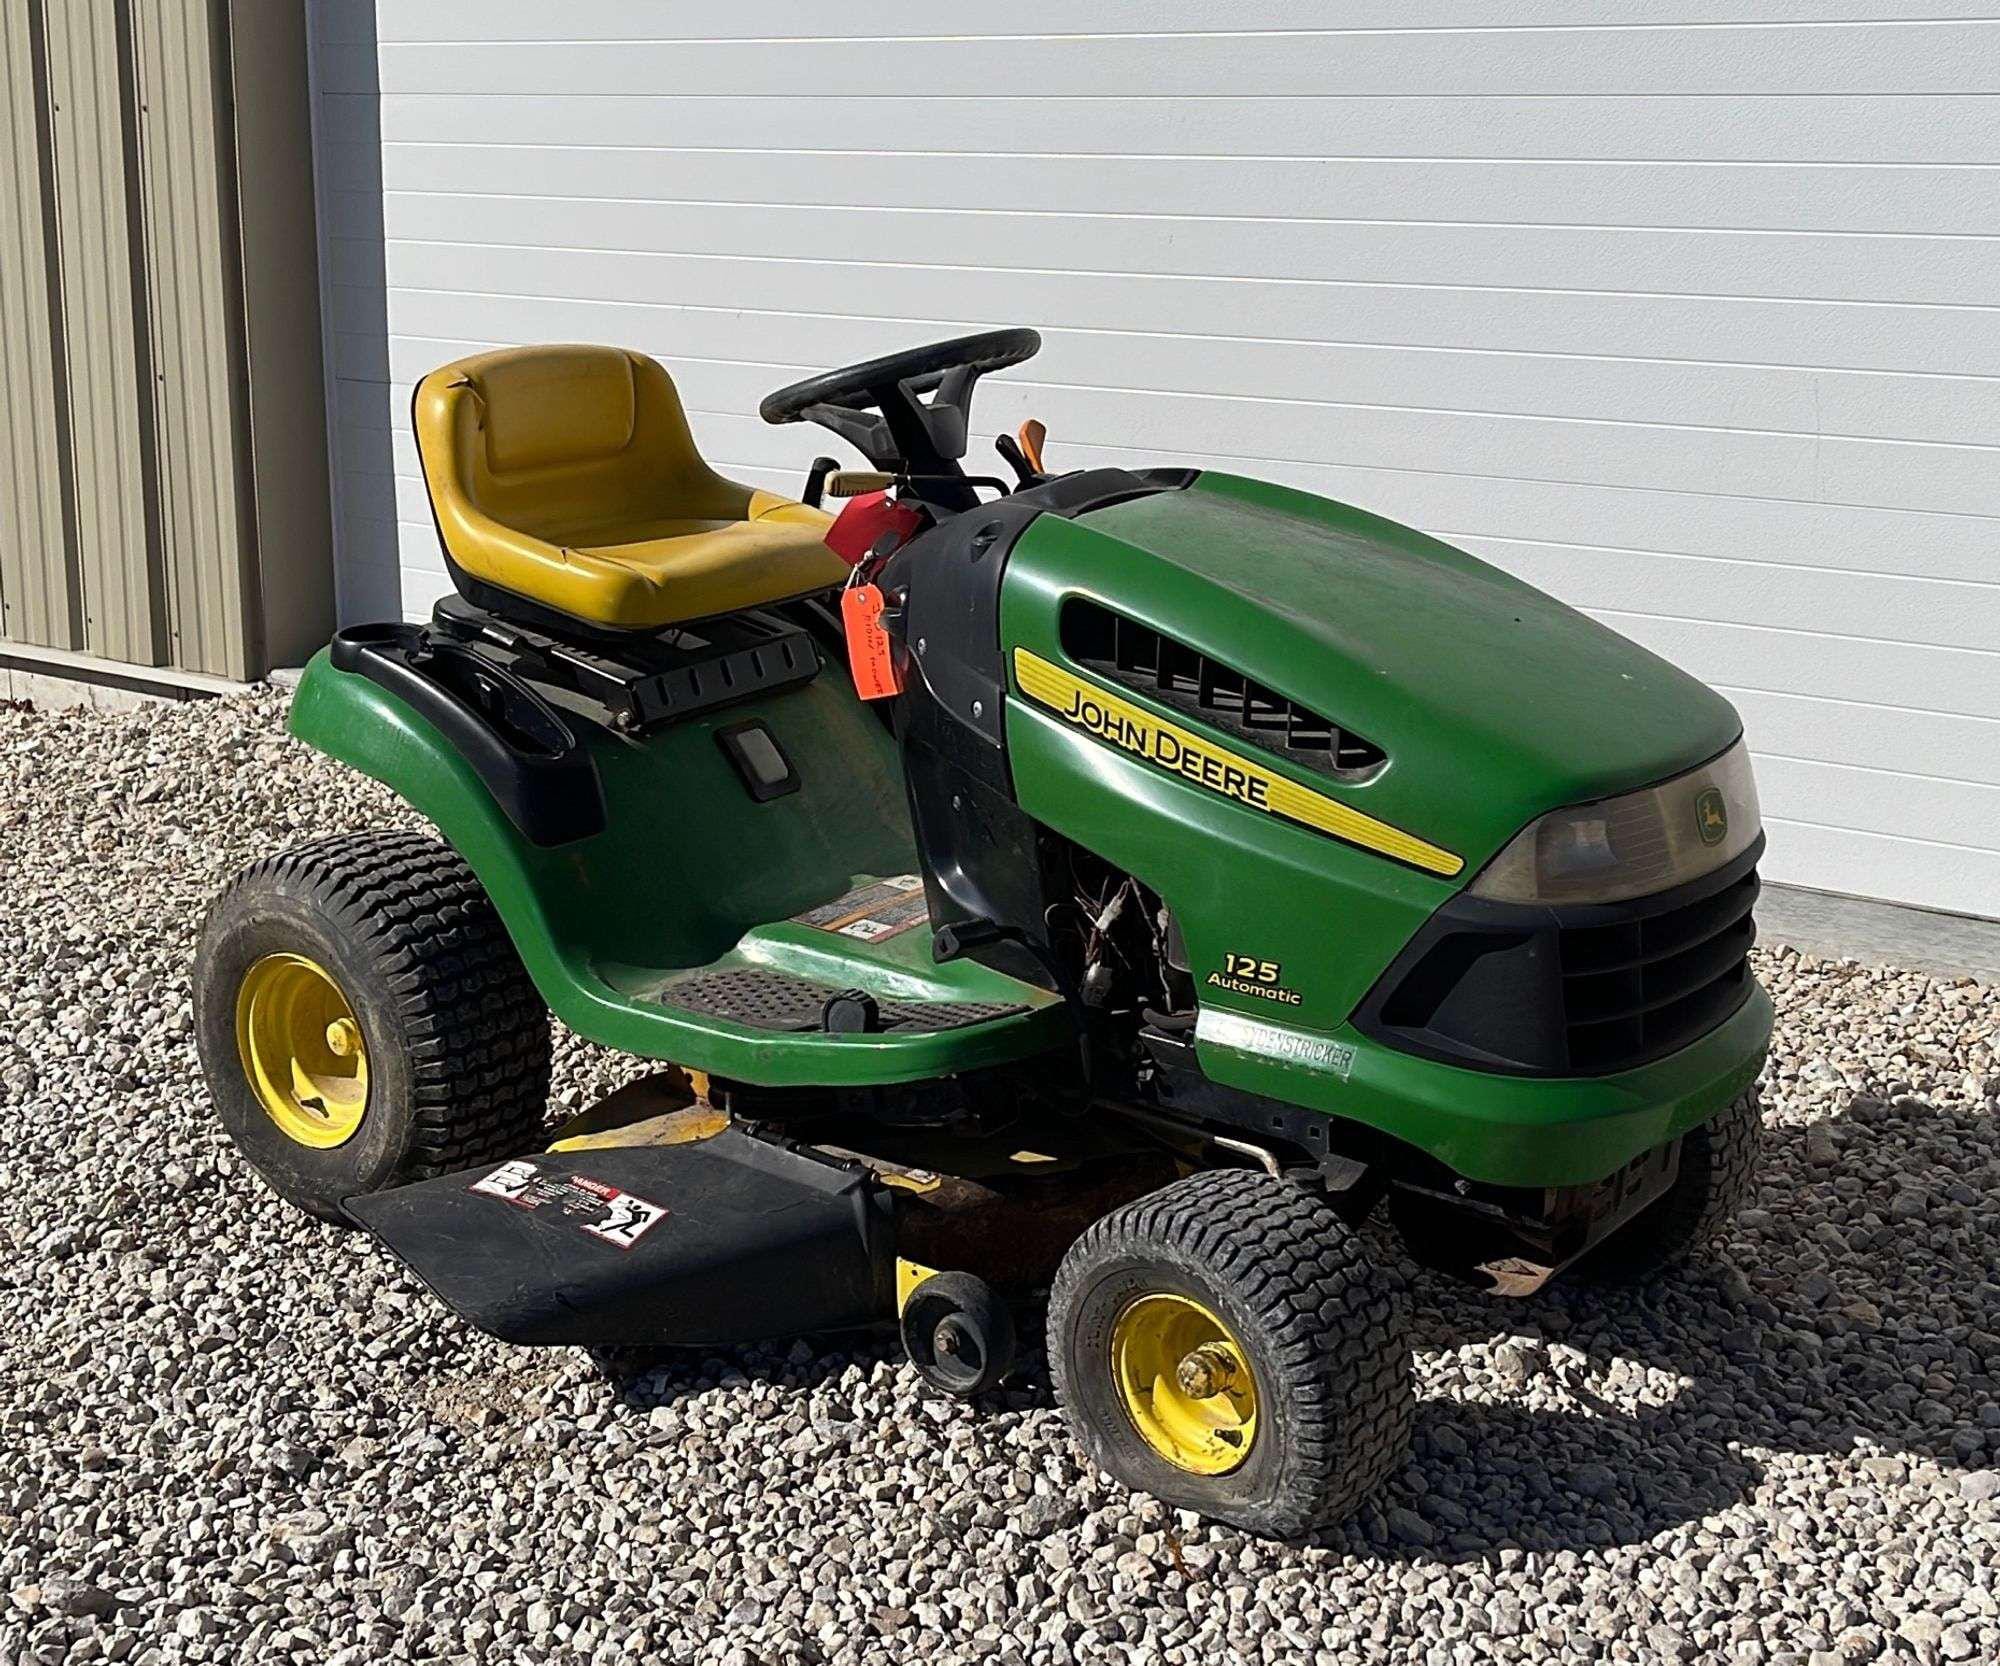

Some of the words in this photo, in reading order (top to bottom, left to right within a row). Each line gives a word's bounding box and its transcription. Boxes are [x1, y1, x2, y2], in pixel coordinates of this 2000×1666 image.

[1063, 690, 1149, 754] JOHN
[1155, 736, 1269, 807] DEERE
[1226, 953, 1279, 983] 125
[1207, 972, 1301, 1005] Automatic
